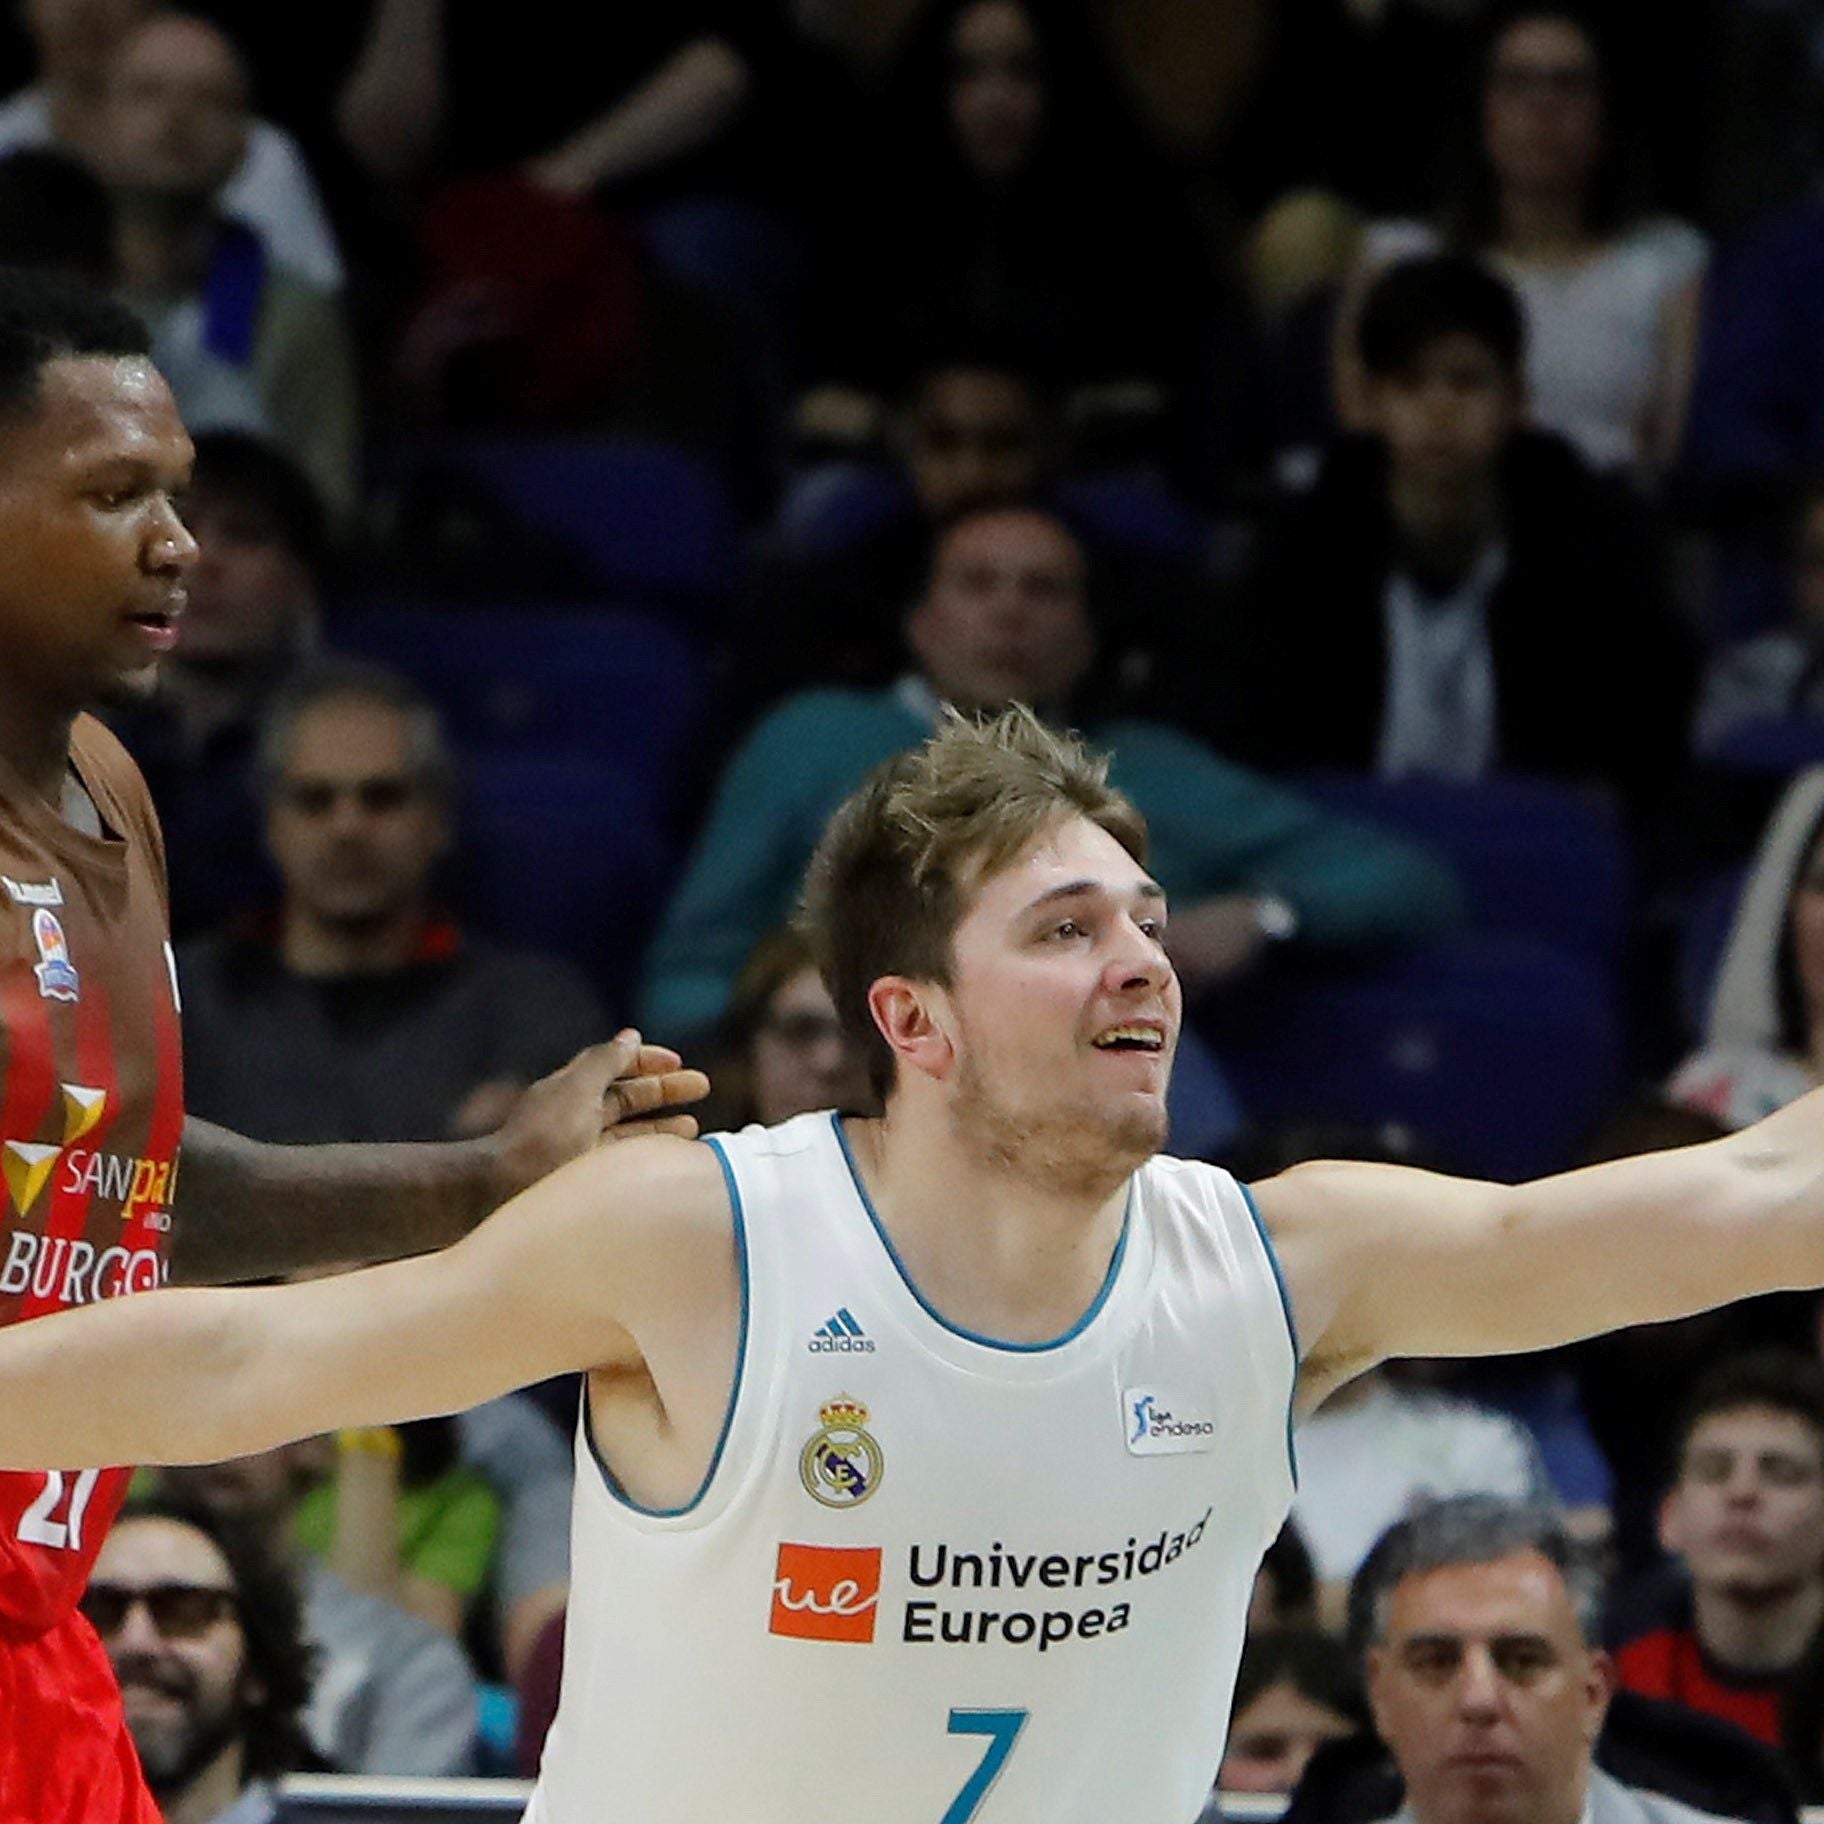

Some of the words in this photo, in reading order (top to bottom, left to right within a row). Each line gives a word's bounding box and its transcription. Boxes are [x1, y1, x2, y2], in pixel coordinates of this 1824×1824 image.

[808, 1336, 876, 1353] adidas
[910, 1506, 1213, 1588] Universidad
[903, 1600, 1131, 1652] Europea
